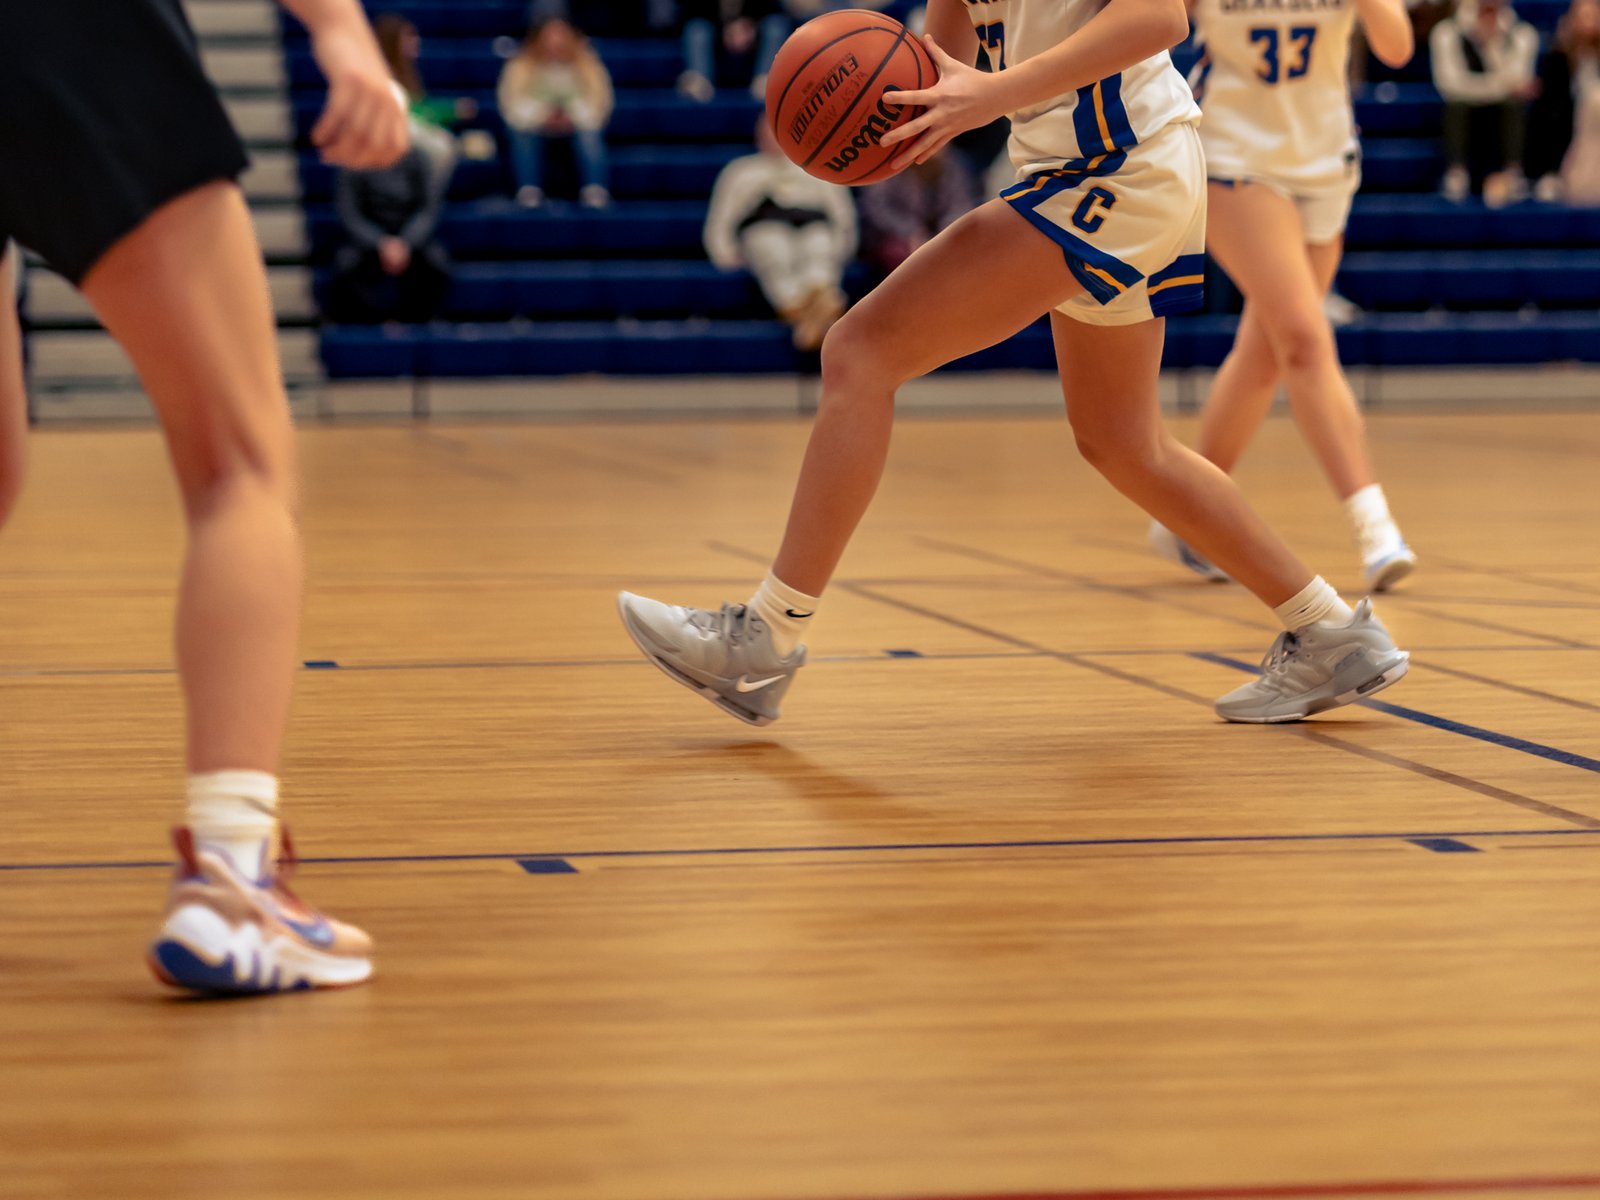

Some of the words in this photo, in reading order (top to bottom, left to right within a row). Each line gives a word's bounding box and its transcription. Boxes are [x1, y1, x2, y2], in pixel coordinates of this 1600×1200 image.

[1248, 24, 1318, 86] 33
[790, 56, 859, 145] EVOLUTION
[824, 83, 908, 173] Wilson
[1071, 184, 1118, 235] C
